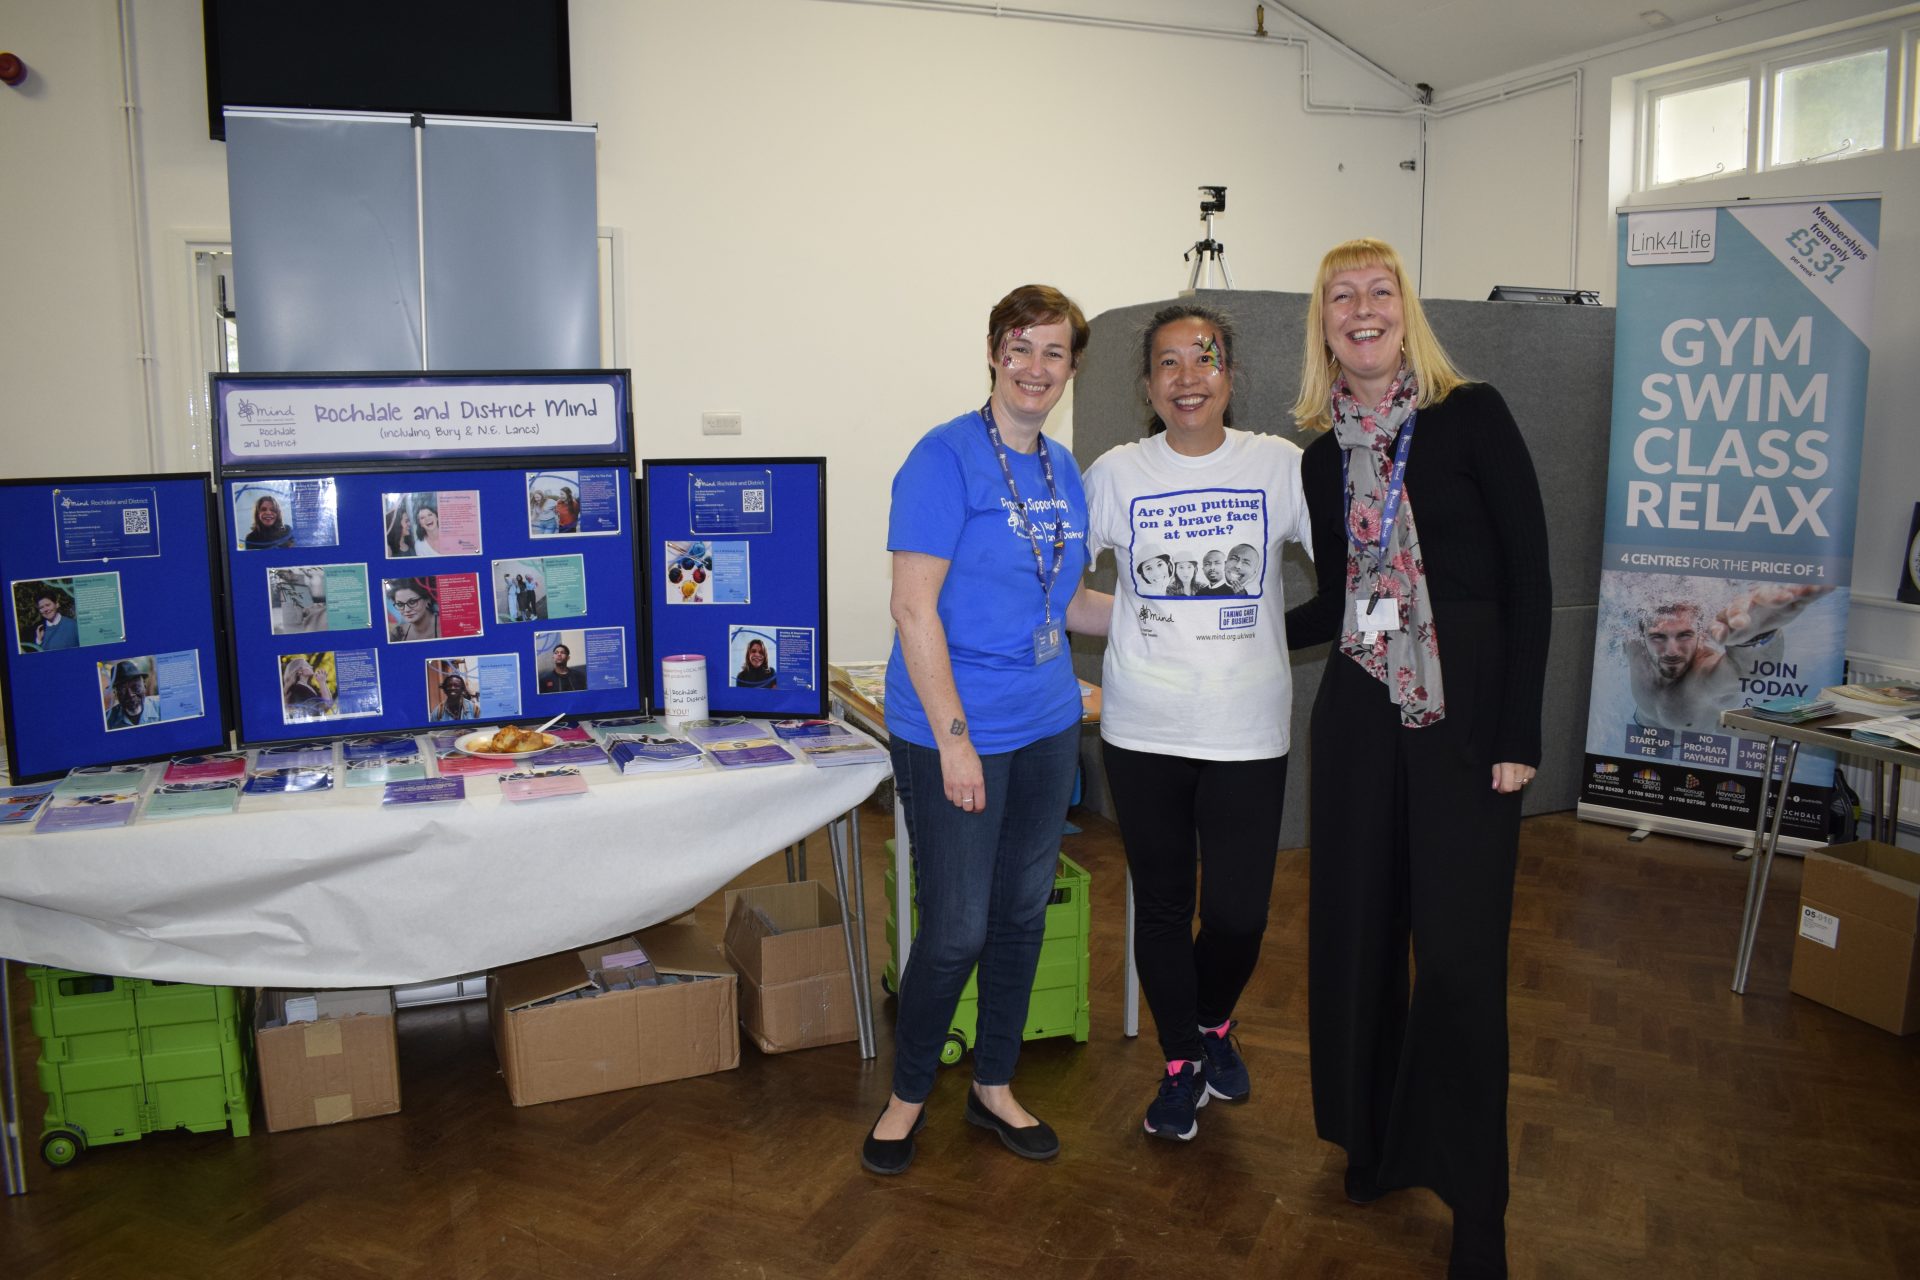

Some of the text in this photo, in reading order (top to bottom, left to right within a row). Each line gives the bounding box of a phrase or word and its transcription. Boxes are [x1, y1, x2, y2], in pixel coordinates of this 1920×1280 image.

[1812, 206, 1868, 260] Memberships
[1631, 229, 1711, 252] Link4Life
[1810, 223, 1850, 262] from only
[1785, 228, 1846, 284] £5.31
[1790, 255, 1800, 265] per
[1660, 316, 1813, 366] GYM
[1639, 373, 1829, 422] SWIM
[255, 405, 295, 417] mind
[314, 398, 598, 423] Rochdale and District Mind
[259, 427, 296, 436] Rochdale
[380, 423, 540, 440] (including Bury & N.E. Lancs)
[244, 439, 297, 448] and District
[1633, 427, 1830, 480] CLASS
[1137, 498, 1260, 517] Are you putting
[1625, 480, 1834, 537] RELAX
[1139, 511, 1258, 529] on a brave face
[1164, 525, 1234, 540] at work?
[1621, 552, 1825, 577] 4 CENTRES FOR THE PRICE OF 1
[1150, 613, 1175, 623] mind
[1231, 616, 1254, 625] BUSINESS
[1749, 660, 1797, 679] JOIN
[1738, 677, 1808, 698] TODAY
[1643, 728, 1658, 736] NO
[1629, 735, 1670, 748] START-UP
[1699, 735, 1713, 744] NO
[1641, 746, 1657, 755] FEE
[1683, 743, 1728, 756] PRO-RATA
[1739, 750, 1745, 758] 3
[1683, 752, 1726, 765] PAYMENT
[1754, 762, 1780, 772] PRE
[1715, 791, 1746, 800] Heywood
[1783, 809, 1822, 820] OCHDALE
